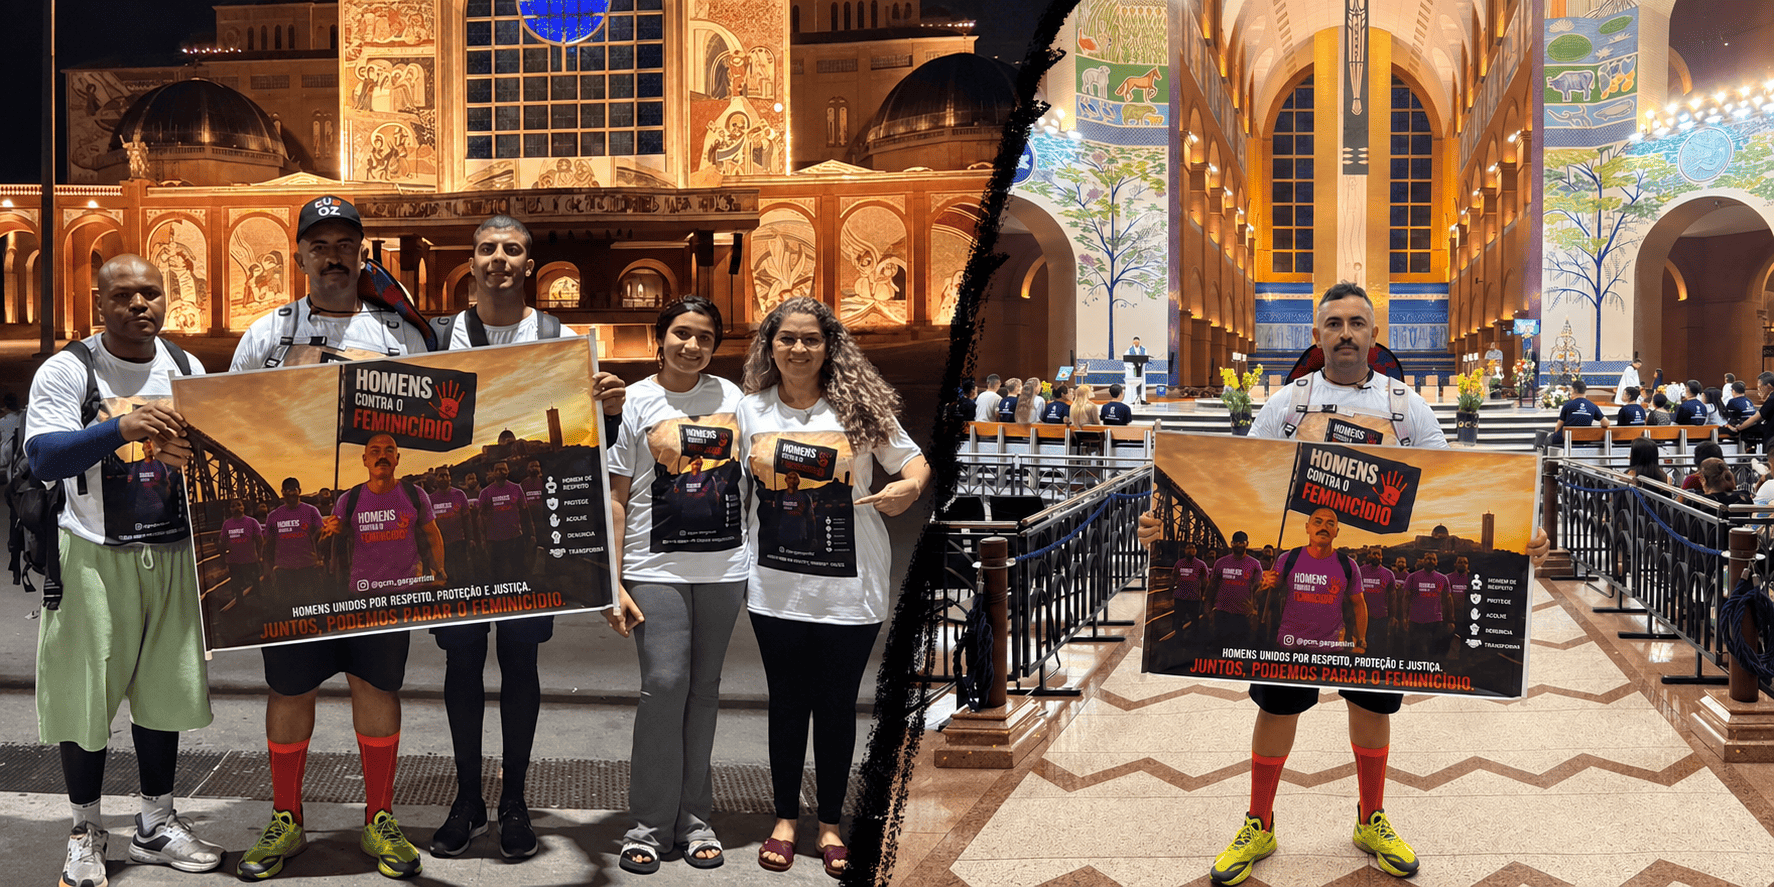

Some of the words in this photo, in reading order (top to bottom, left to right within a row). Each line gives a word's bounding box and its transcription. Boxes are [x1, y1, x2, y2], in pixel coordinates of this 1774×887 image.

[318, 206, 341, 216] OZ
[356, 368, 433, 399] HOMENS
[355, 392, 393, 411] CONTRA
[396, 399, 403, 412] O
[353, 408, 453, 443] FEMINICÍDIO
[782, 443, 817, 458] HOMENS
[1306, 467, 1340, 490] CONTRA
[1342, 480, 1350, 492] O
[1310, 448, 1379, 485] HOMENS
[357, 509, 396, 524] HOMENS
[1301, 482, 1392, 526] FEMINICÍDIO
[1293, 572, 1328, 586] HOMENS
[292, 603, 331, 618] HOMENS
[333, 598, 367, 613] UNIDOS
[369, 596, 388, 609] POR
[437, 584, 482, 601] PROTEÇÃO
[484, 585, 491, 596] E
[492, 581, 532, 596] JUSTIÇA.
[260, 617, 323, 640] JUNTOS,
[327, 608, 398, 632] PODEMOS
[403, 603, 452, 623] PARAR
[457, 601, 467, 617] O
[472, 591, 566, 616] FEMINICÍDIO.
[1222, 647, 1257, 660] HOMENS
[1260, 650, 1291, 662] UNIDOS
[1292, 652, 1309, 664] POR
[1311, 653, 1352, 668] RESPEITO,
[1354, 656, 1397, 671] PROTEÇÃO
[1399, 659, 1404, 670] E
[1406, 660, 1443, 673] JUSTIÇA.
[1190, 658, 1246, 678] JUNTOS,
[1251, 661, 1317, 681] PODEMOS
[1321, 667, 1367, 684] PARAR
[1371, 670, 1380, 685] O
[1385, 671, 1475, 691] FEMINICÍDIO.
